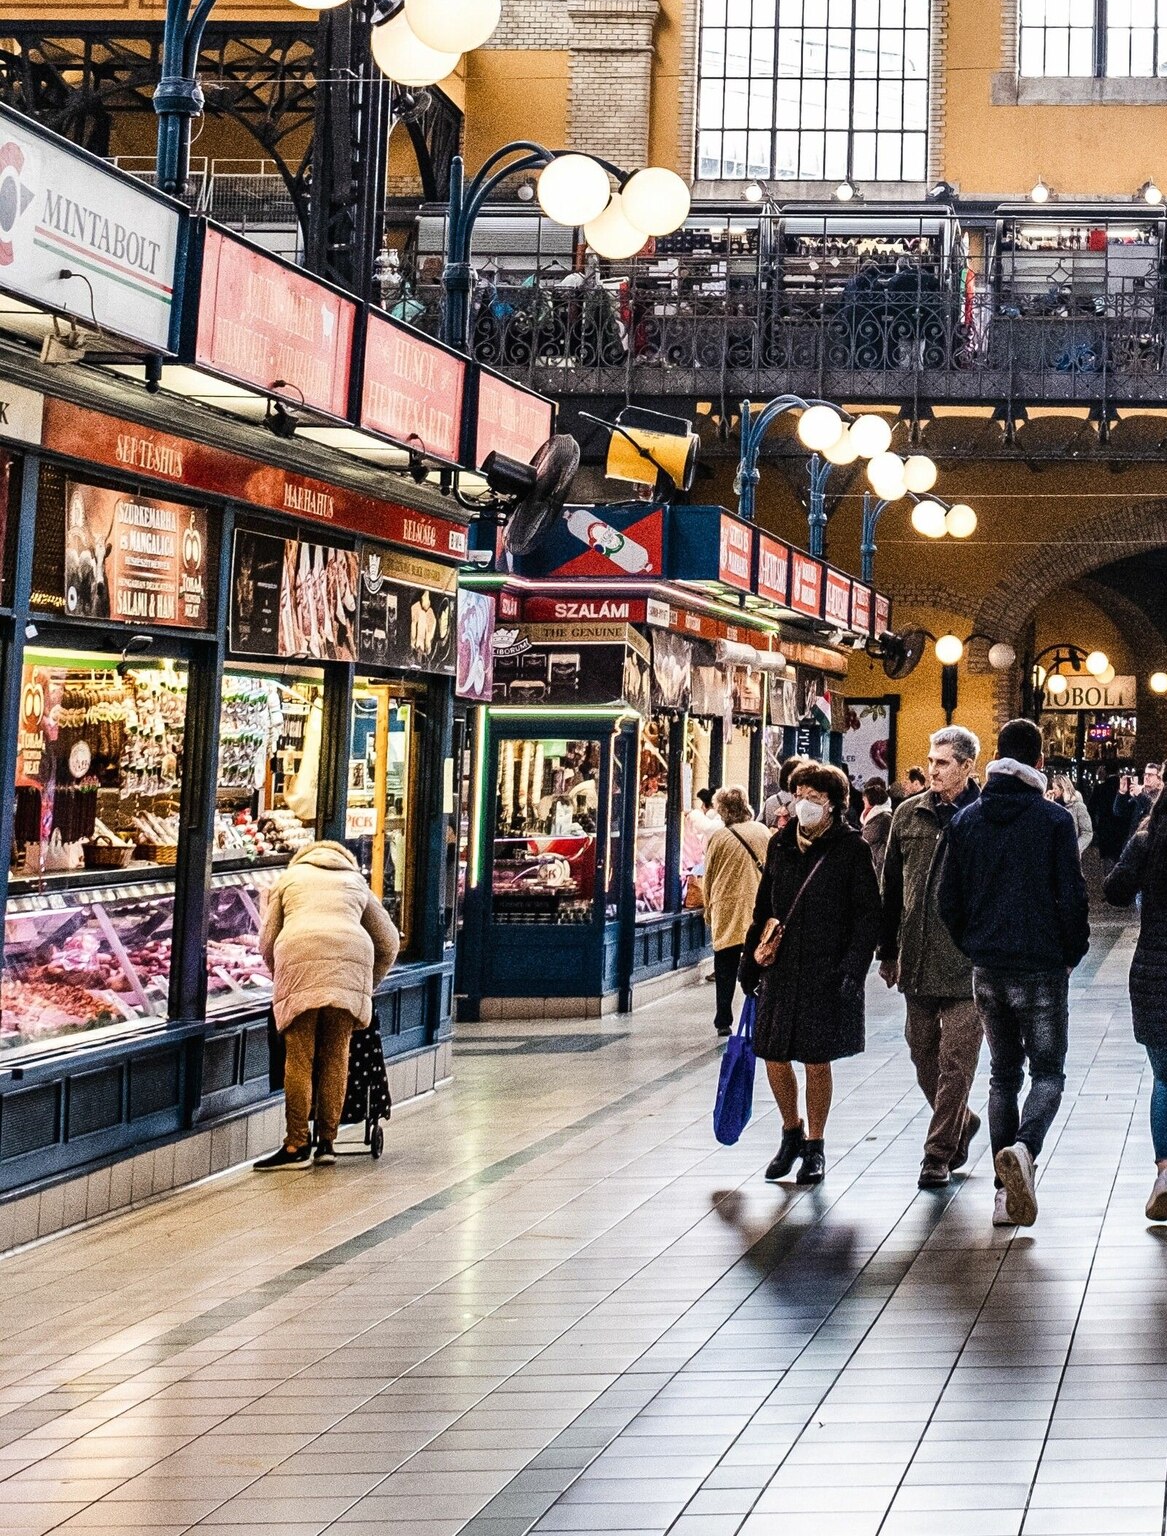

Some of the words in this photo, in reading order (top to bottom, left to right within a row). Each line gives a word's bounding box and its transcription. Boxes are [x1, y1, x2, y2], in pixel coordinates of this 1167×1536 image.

[42, 189, 160, 274] MINTABOLT
[115, 434, 184, 478] SERTÉSHÚS
[116, 590, 148, 617] SALAMI
[148, 593, 156, 618] &
[555, 601, 629, 618] SZALÁMI
[544, 628, 567, 637] THE
[571, 627, 622, 638] GENUINE
[1045, 687, 1124, 707] IOBOLT
